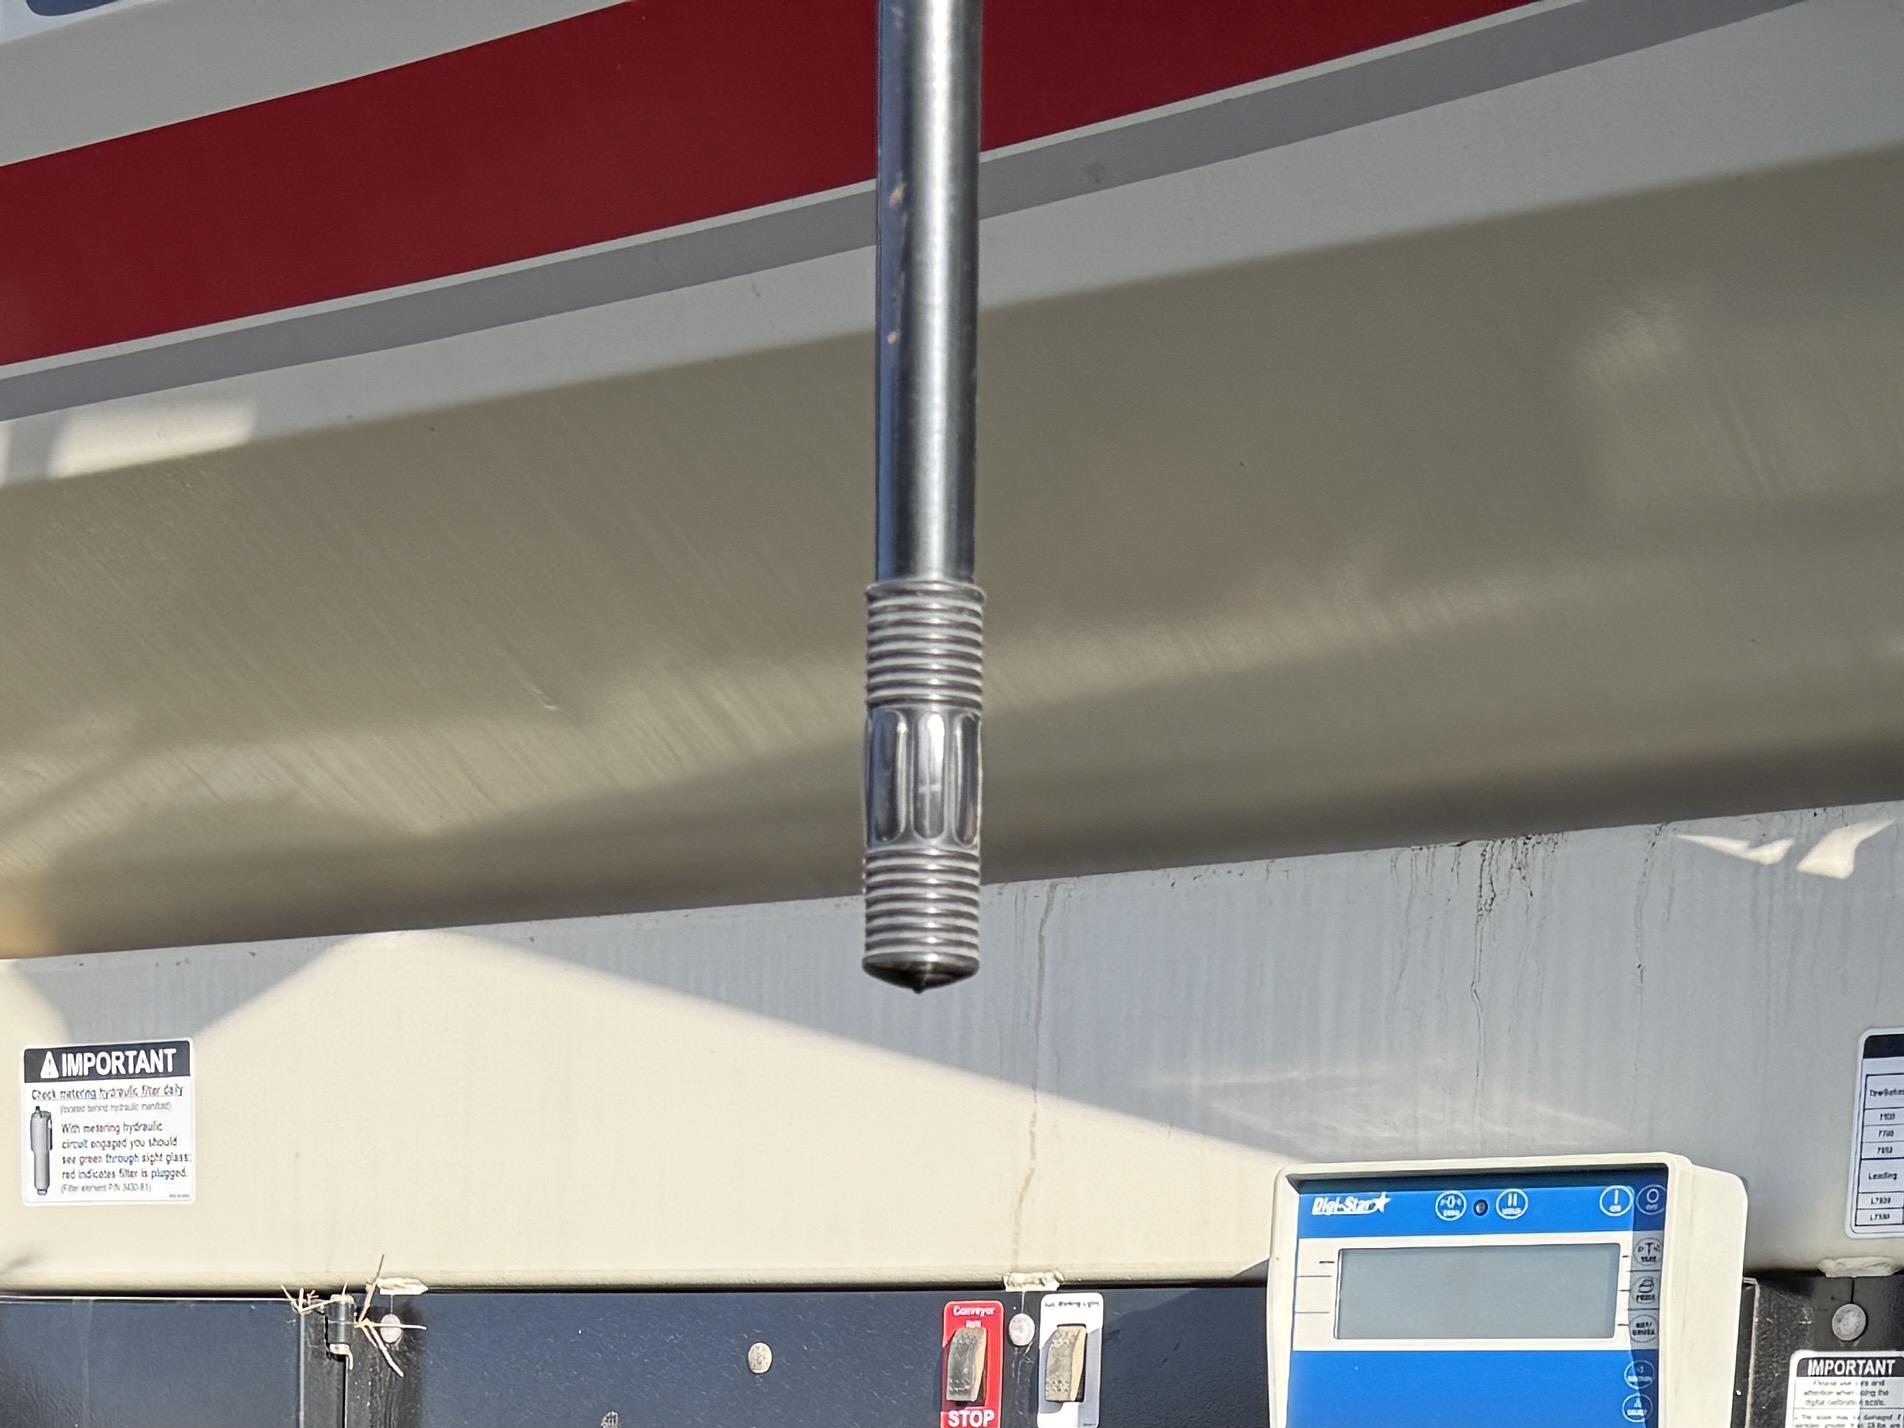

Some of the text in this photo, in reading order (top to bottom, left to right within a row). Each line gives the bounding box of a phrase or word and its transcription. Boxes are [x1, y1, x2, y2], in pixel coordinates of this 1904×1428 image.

[62, 1049, 176, 1076] IMPORTANT
[83, 1124, 120, 1135] metering
[123, 1121, 162, 1133] hydraulic
[130, 1139, 145, 1150] you
[149, 1137, 177, 1147] should
[79, 1156, 103, 1166] green
[106, 1154, 139, 1165] through
[62, 1170, 75, 1179] red
[79, 1169, 115, 1179] indicates
[119, 1168, 137, 1178] filter
[1312, 1196, 1379, 1215] Digi-Star
[953, 1305, 996, 1317] Conveyor
[1808, 1359, 1895, 1376] IMPORTANT
[948, 1410, 995, 1428] STOP
